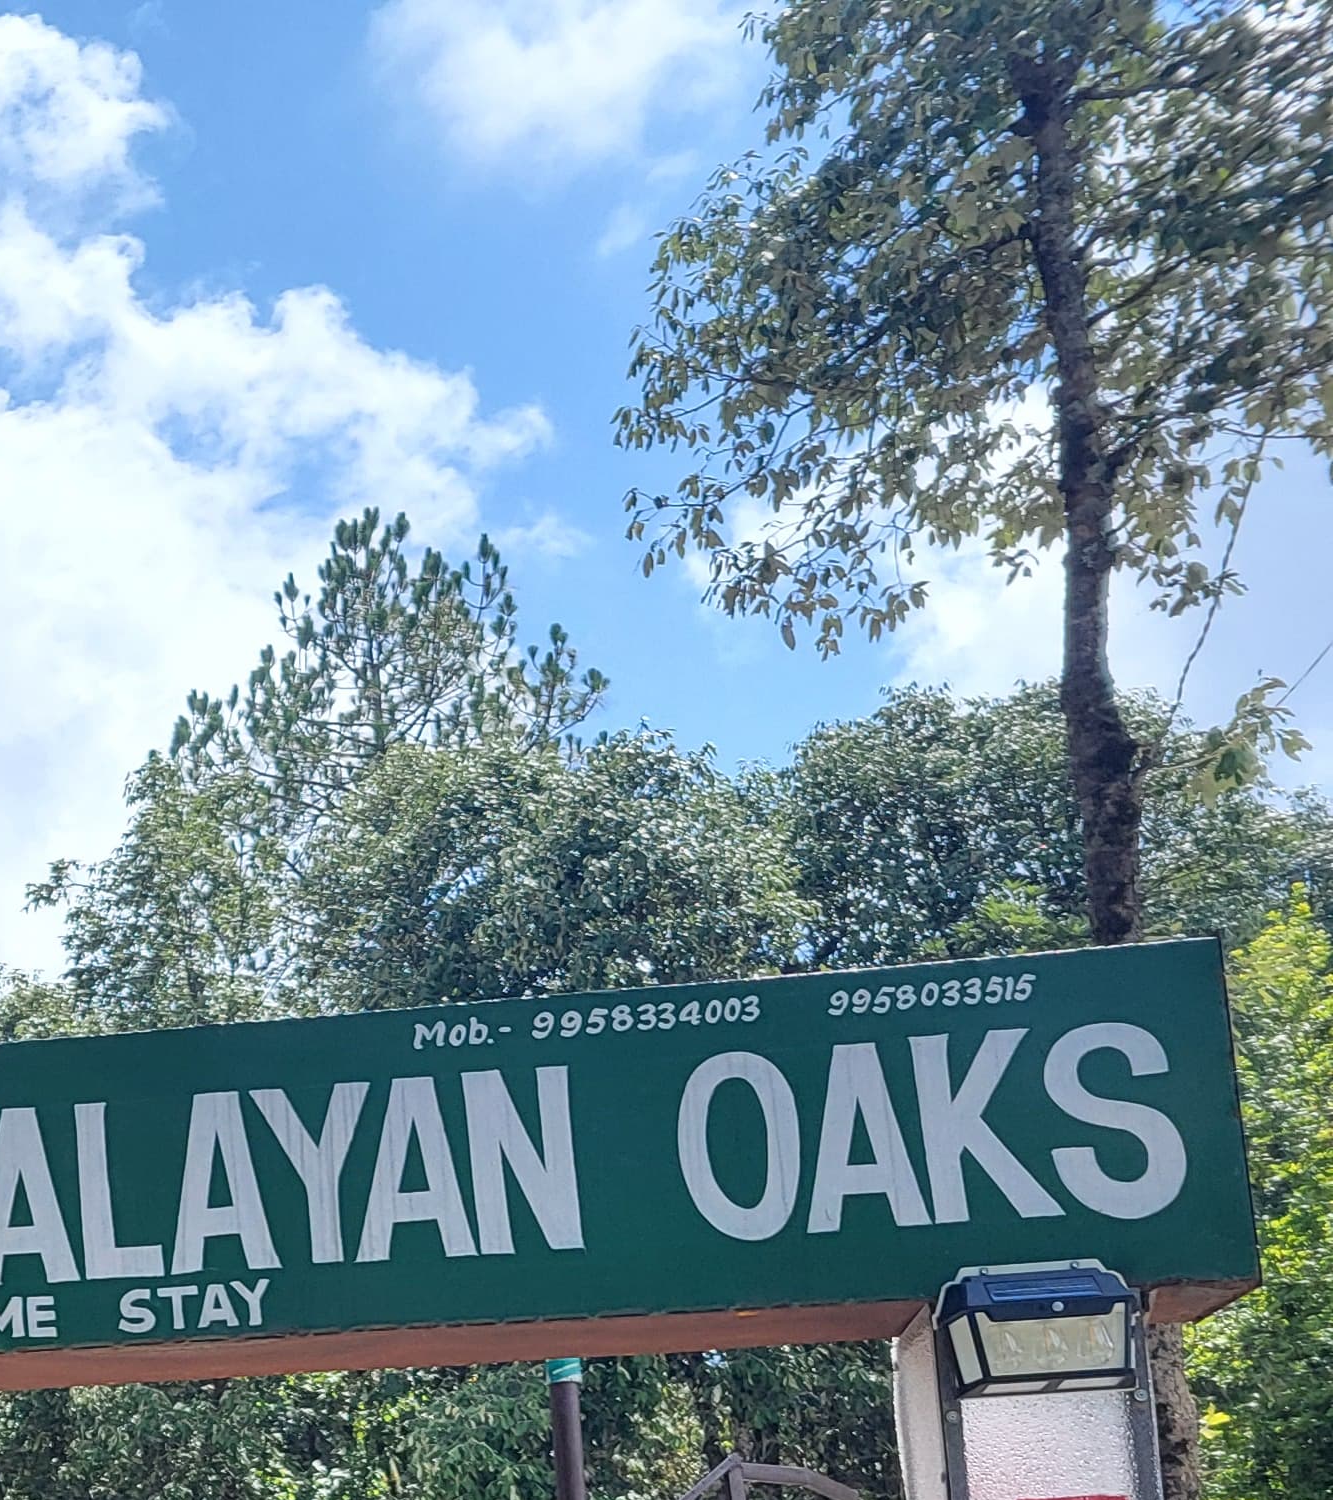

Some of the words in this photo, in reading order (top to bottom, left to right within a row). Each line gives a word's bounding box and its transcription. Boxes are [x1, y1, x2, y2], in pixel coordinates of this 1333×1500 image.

[532, 996, 760, 1040] 9958334003
[828, 974, 1036, 1016] 9958033515
[677, 1021, 1187, 1241] OAKS
[118, 1278, 270, 1333] STAY
